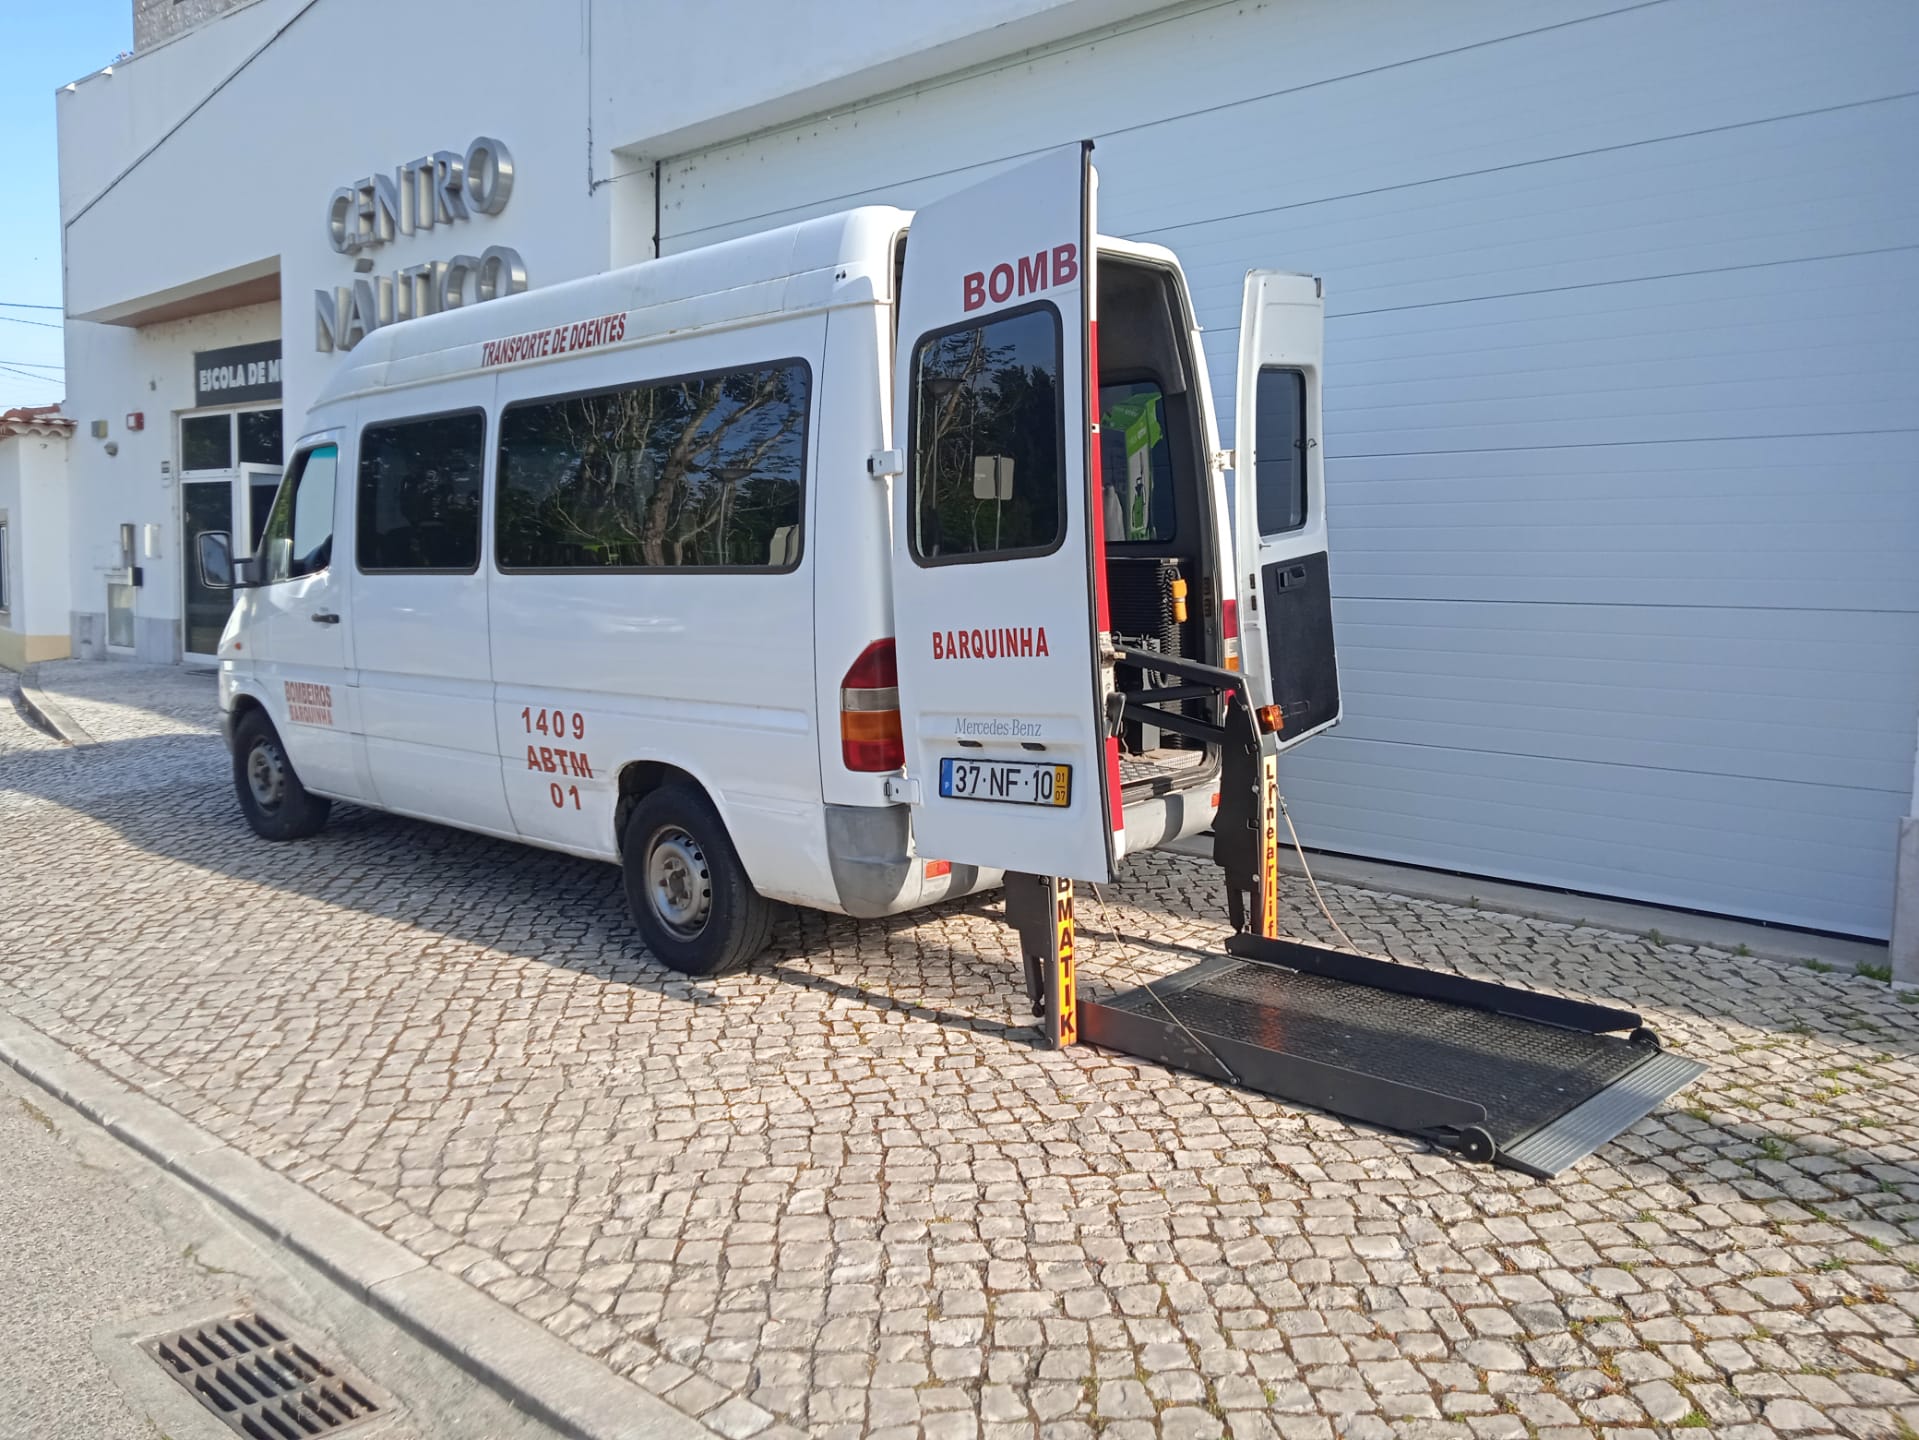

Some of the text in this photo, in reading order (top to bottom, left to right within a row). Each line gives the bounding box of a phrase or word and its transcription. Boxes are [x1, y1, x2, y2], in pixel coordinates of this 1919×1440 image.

[327, 136, 514, 255] CENTRO
[963, 242, 1078, 313] BOMB
[481, 312, 627, 368] TRANSPORTE DE DOENTES
[199, 358, 283, 392] ESCOLA DE M
[932, 626, 1049, 660] BARQUINHA
[284, 680, 332, 708] BOMBEIROS
[521, 706, 585, 740] 1409
[954, 717, 1042, 737] Mercedes-Benz
[527, 744, 594, 779] ABTM
[550, 782, 581, 811] 01
